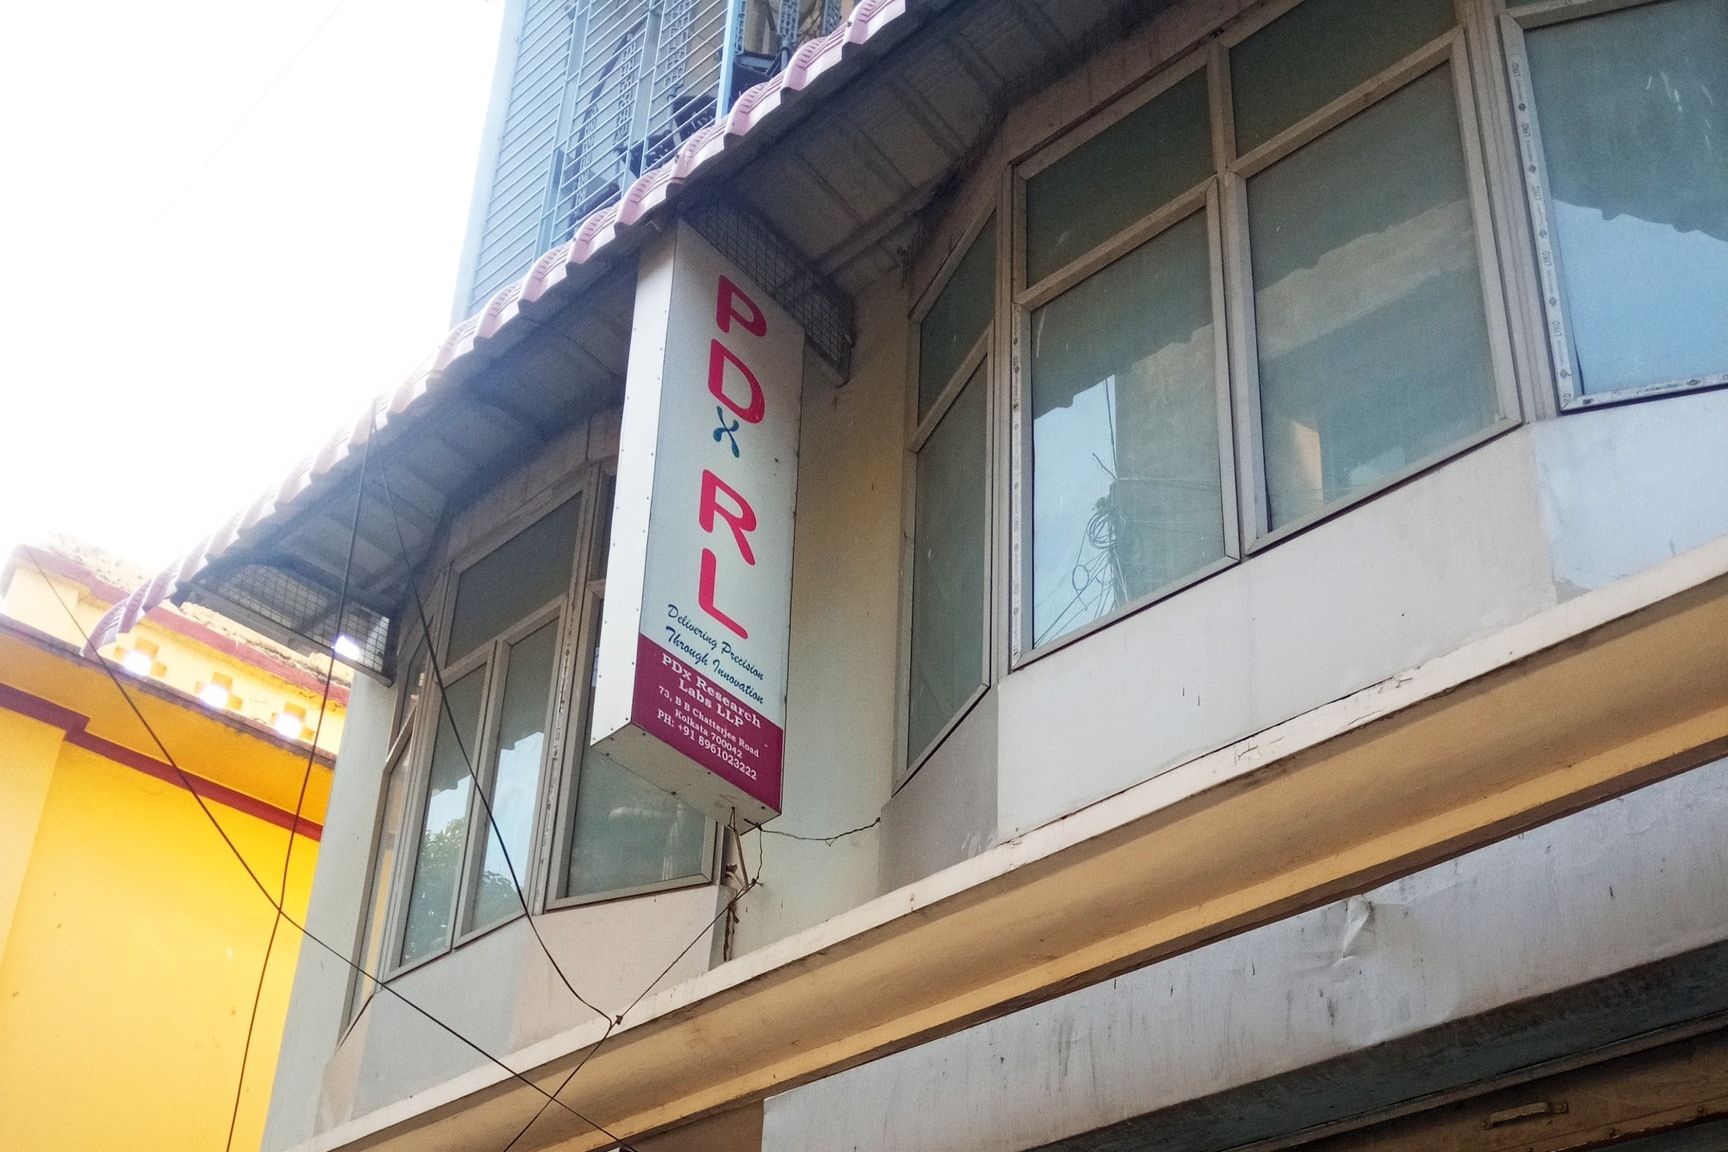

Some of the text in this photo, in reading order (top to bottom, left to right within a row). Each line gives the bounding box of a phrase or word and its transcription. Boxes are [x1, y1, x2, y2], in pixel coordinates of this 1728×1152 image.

[666, 626, 763, 704] Through Innovation
[668, 604, 764, 680] Delivering Precision
[659, 685, 759, 758] 73, B B Chatterjee Road
[662, 653, 761, 728] PDx Research
[679, 678, 744, 727] Labs LLP
[657, 709, 757, 780] PH: +91 8961023222
[675, 709, 743, 759] Kolkata 700042
